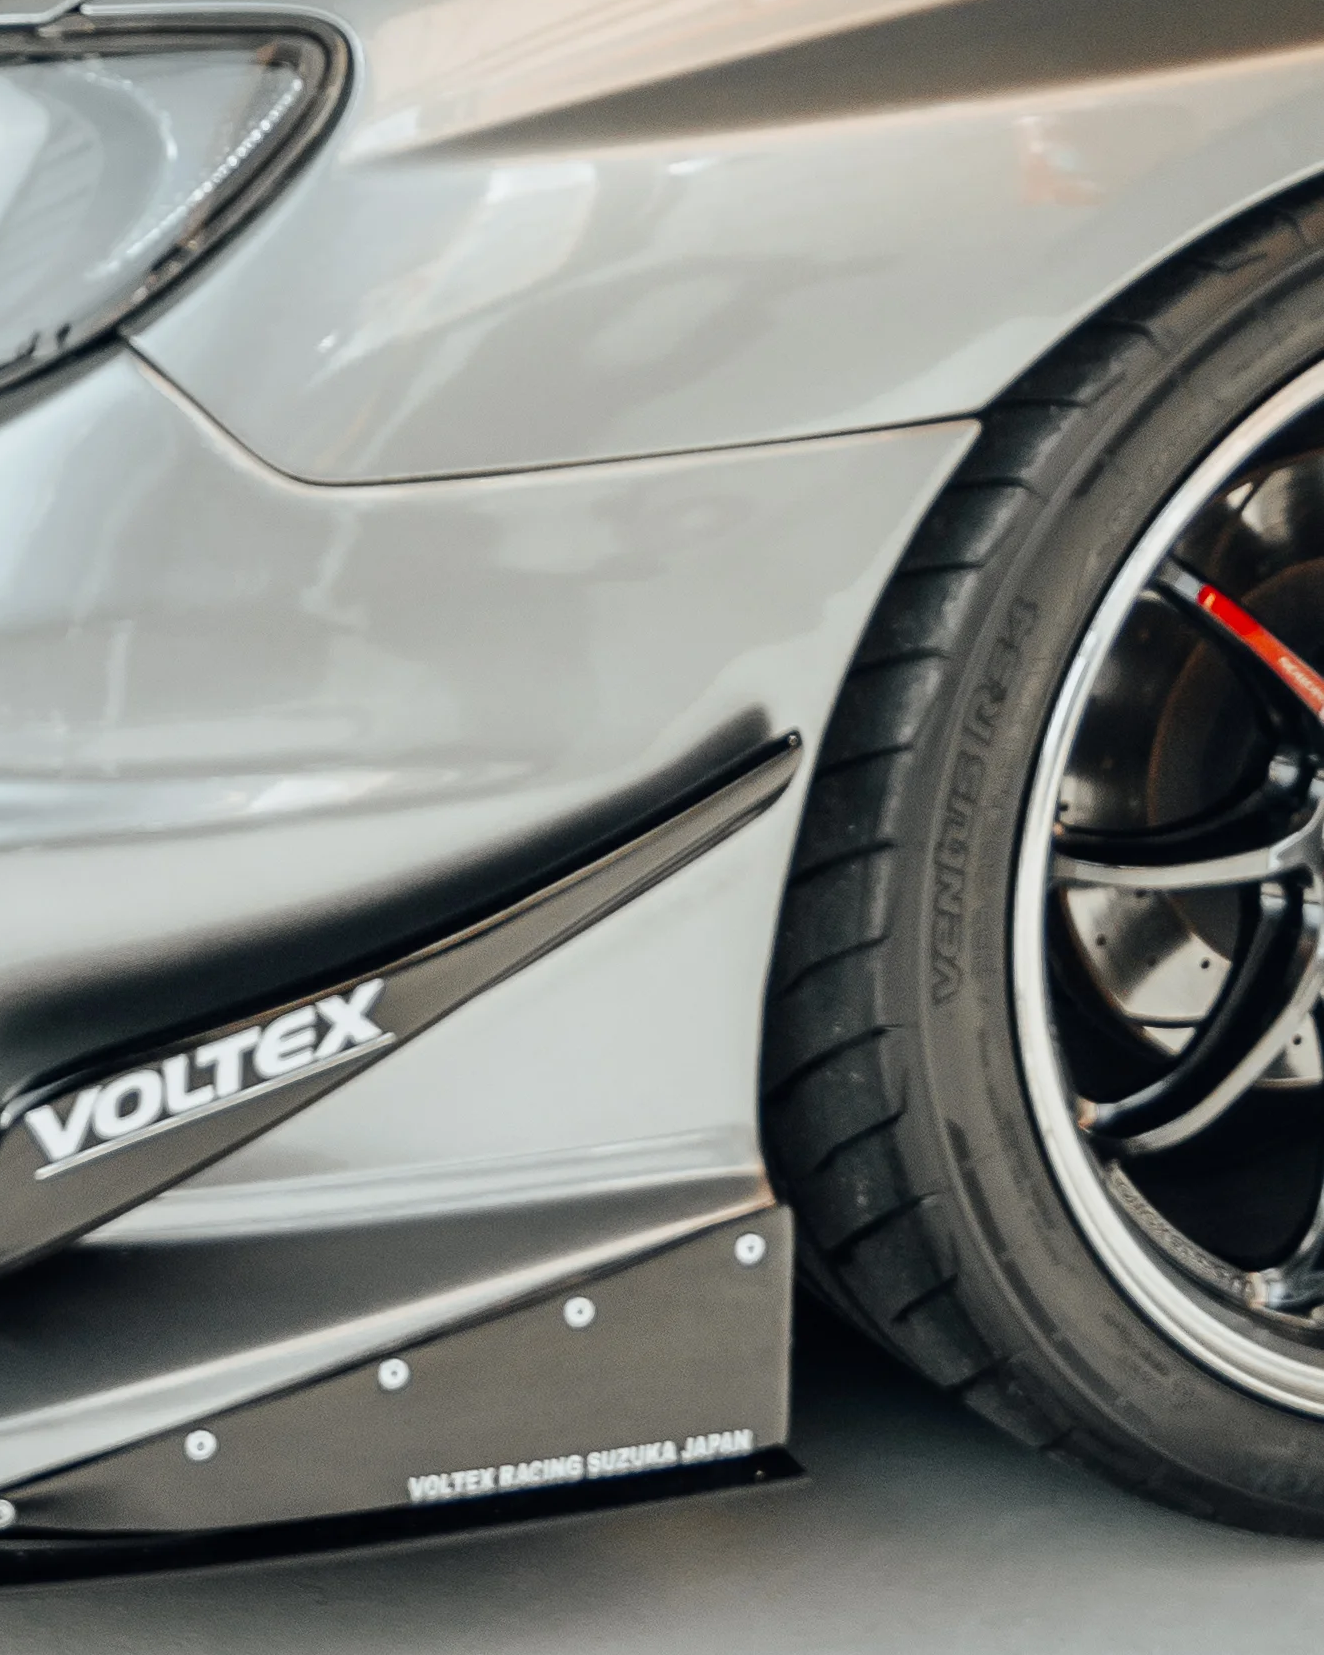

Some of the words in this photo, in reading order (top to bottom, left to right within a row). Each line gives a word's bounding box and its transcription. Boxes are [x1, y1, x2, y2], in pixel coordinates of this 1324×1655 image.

[25, 978, 386, 1159] VOLTEX
[408, 1467, 495, 1503] VOLTEX
[498, 1454, 584, 1488] RACING
[586, 1440, 677, 1474] SUZUKA
[681, 1428, 752, 1463] JAPAN
